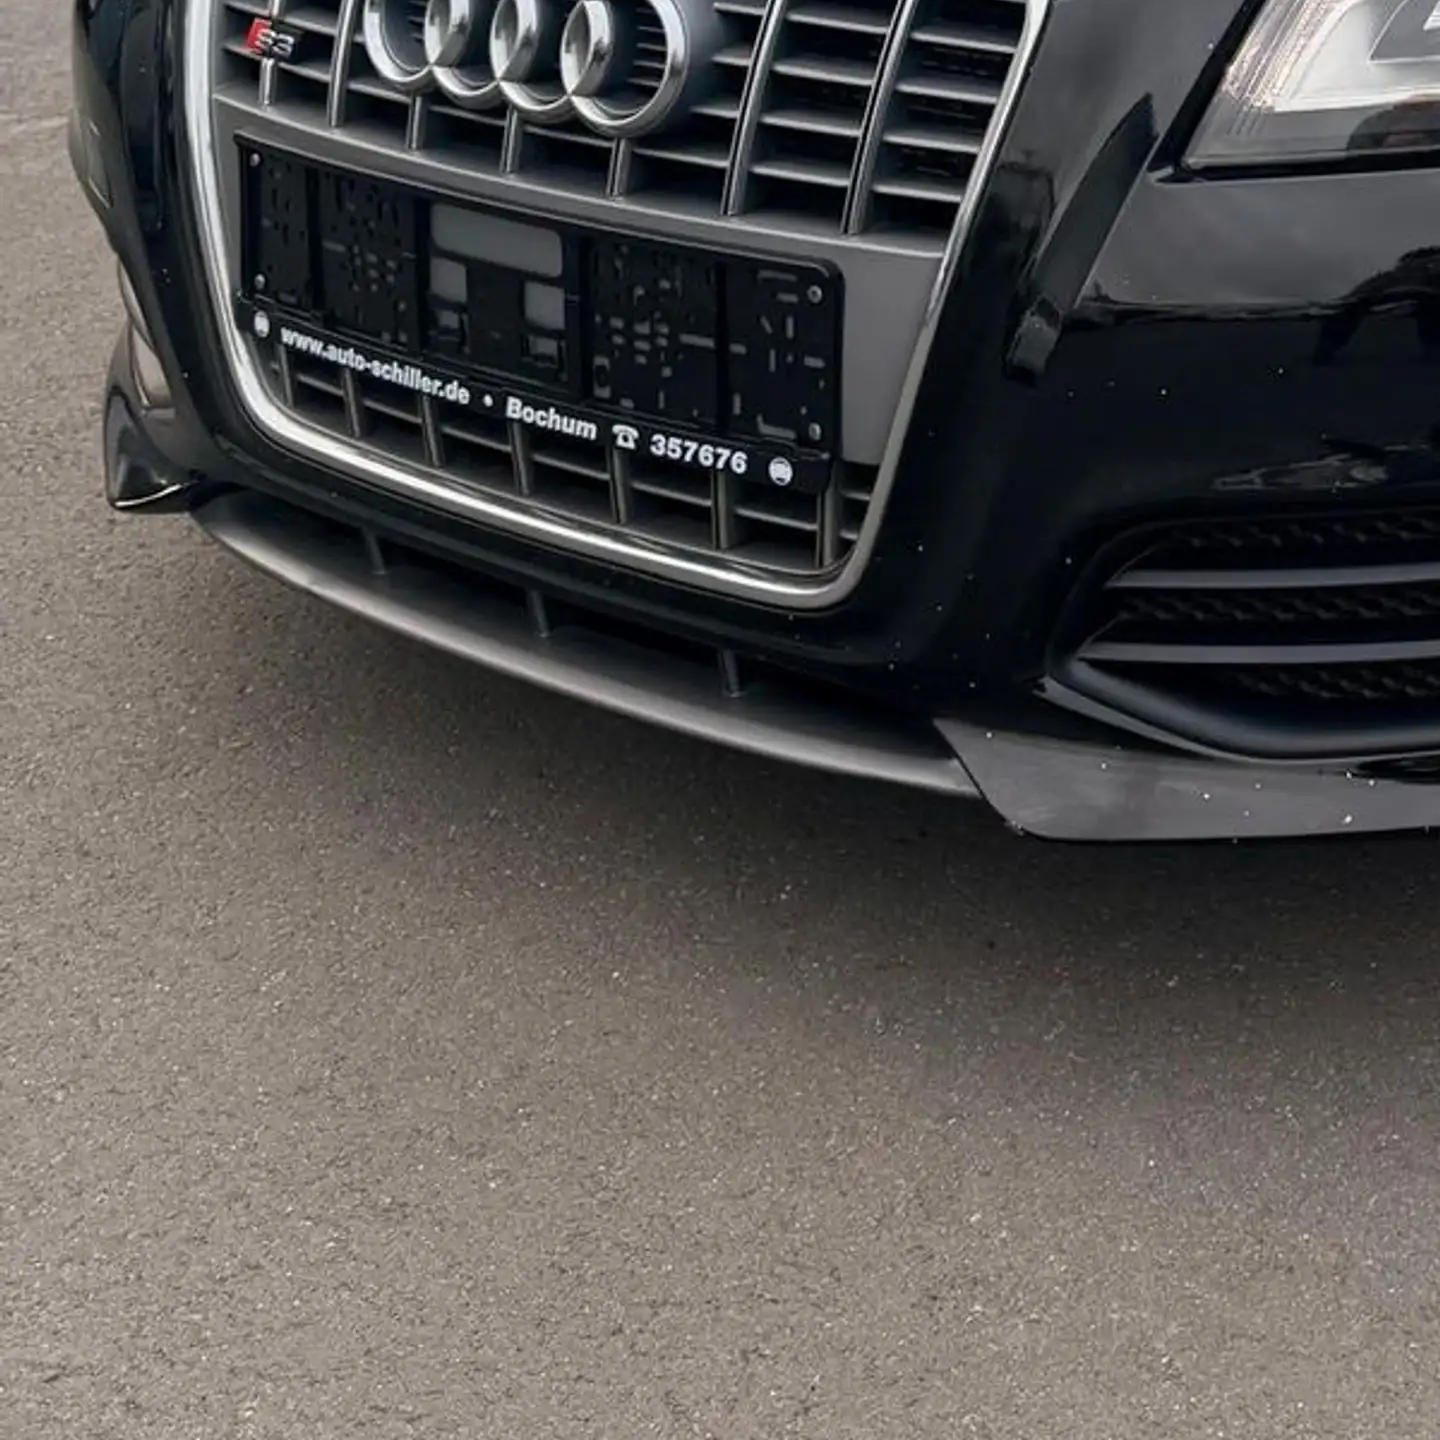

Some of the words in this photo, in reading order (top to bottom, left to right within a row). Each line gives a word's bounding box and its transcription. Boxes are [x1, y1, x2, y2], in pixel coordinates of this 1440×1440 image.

[280, 326, 471, 405] www.auto-schiller.de
[506, 396, 598, 441] Bochum
[650, 433, 748, 475] 357676
